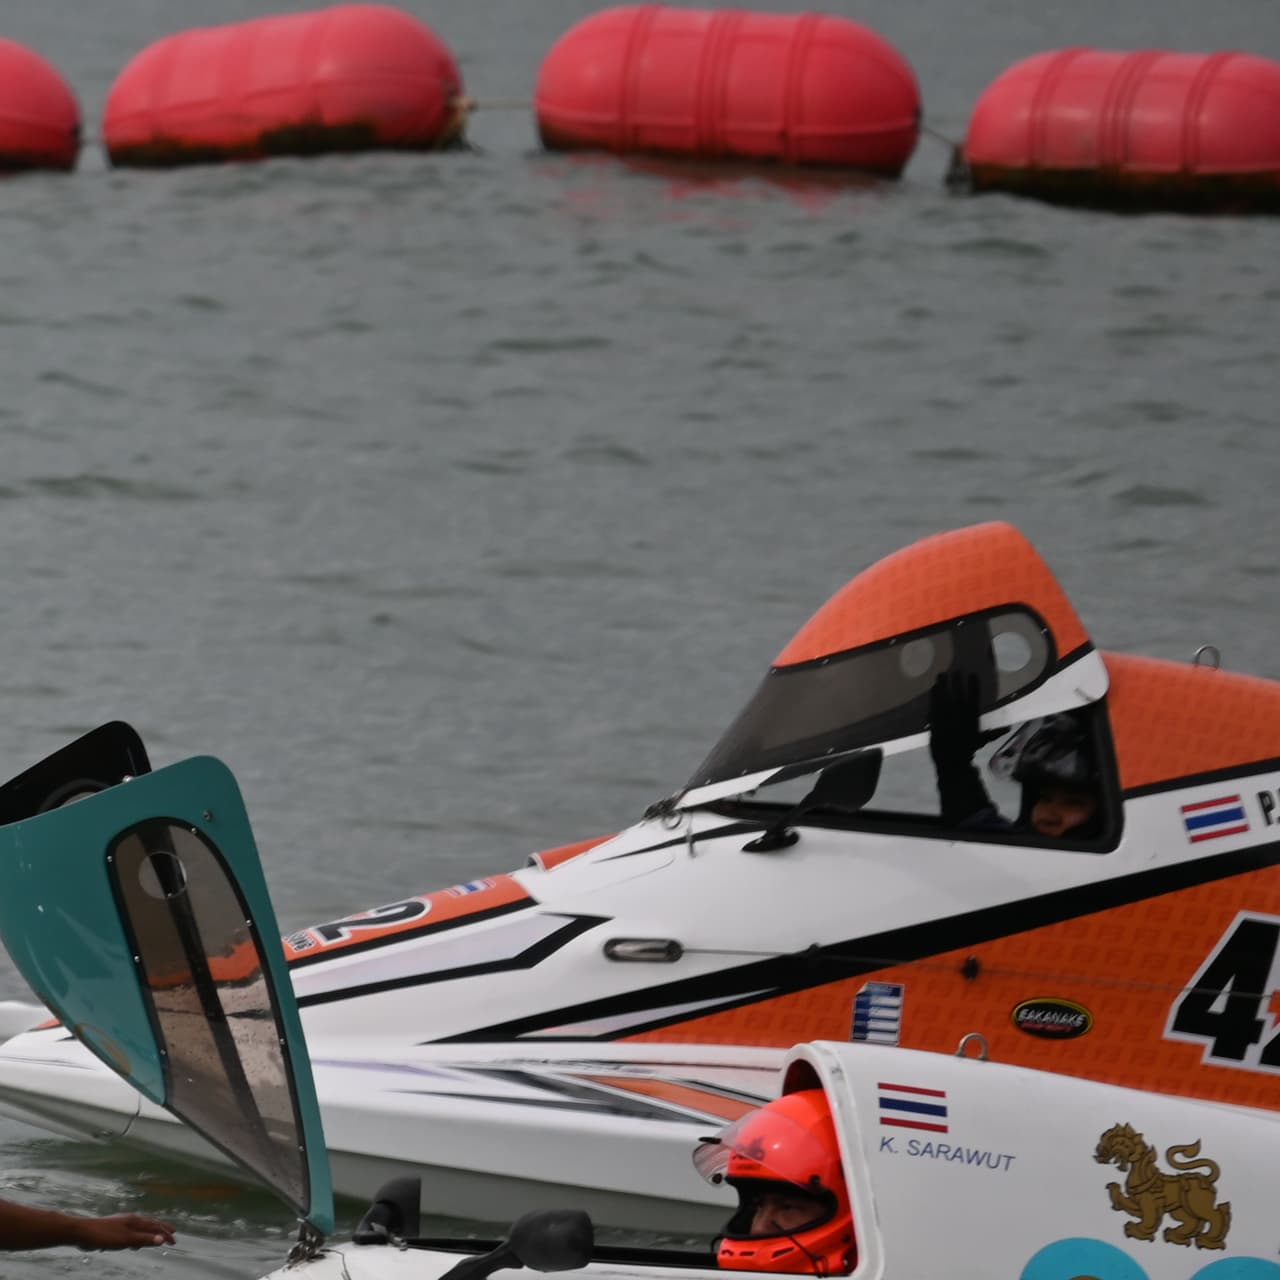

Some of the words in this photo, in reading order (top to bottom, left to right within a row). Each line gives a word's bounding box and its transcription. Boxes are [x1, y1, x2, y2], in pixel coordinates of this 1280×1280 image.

[1164, 912, 1280, 1072] 4
[879, 1136, 898, 1154] K.
[906, 1139, 1017, 1172] SARAWUT
